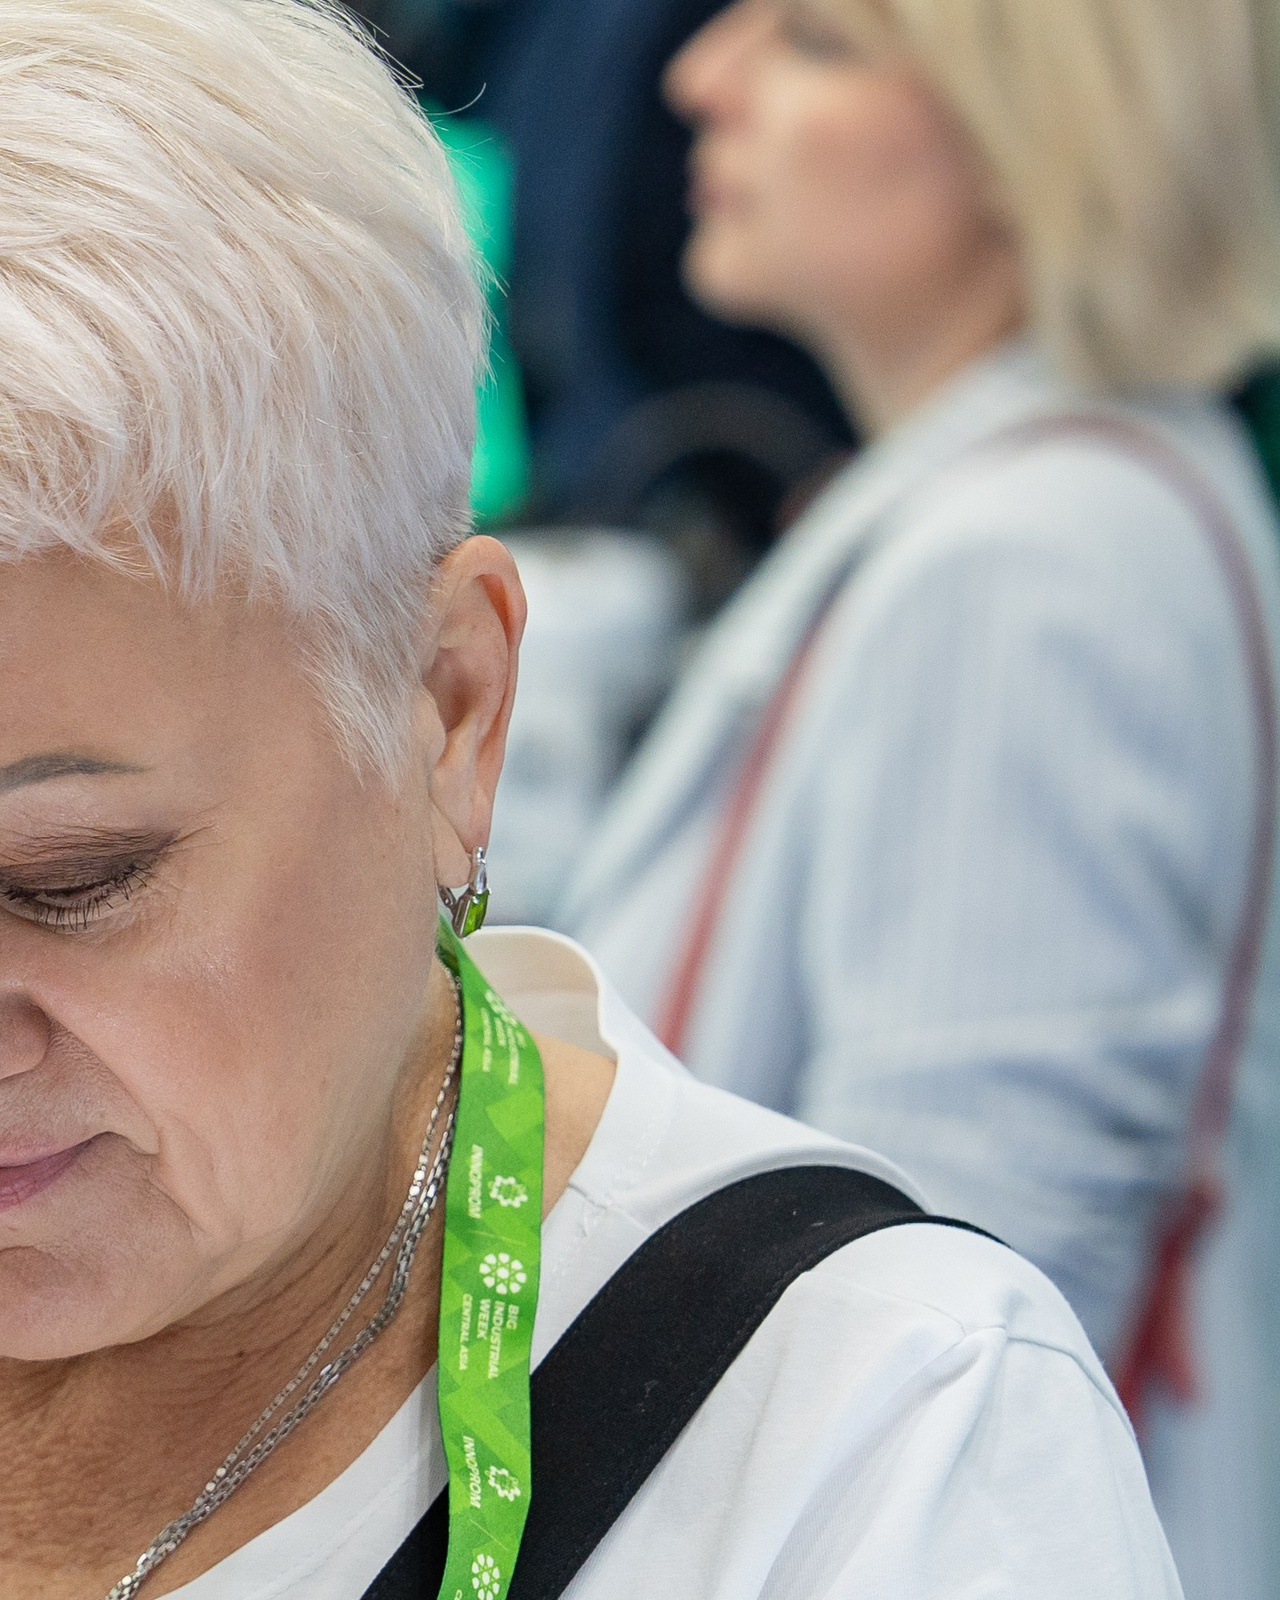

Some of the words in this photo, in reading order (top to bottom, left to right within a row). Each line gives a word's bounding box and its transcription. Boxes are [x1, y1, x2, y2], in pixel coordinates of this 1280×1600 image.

[460, 1293, 473, 1342] CENTRAL
[477, 1299, 491, 1340] WEEK
[488, 1300, 505, 1379] INDUSTRIAL
[506, 1304, 519, 1330] BIG
[459, 1345, 469, 1370] ASIA
[463, 1436, 481, 1508] INNOPROM
